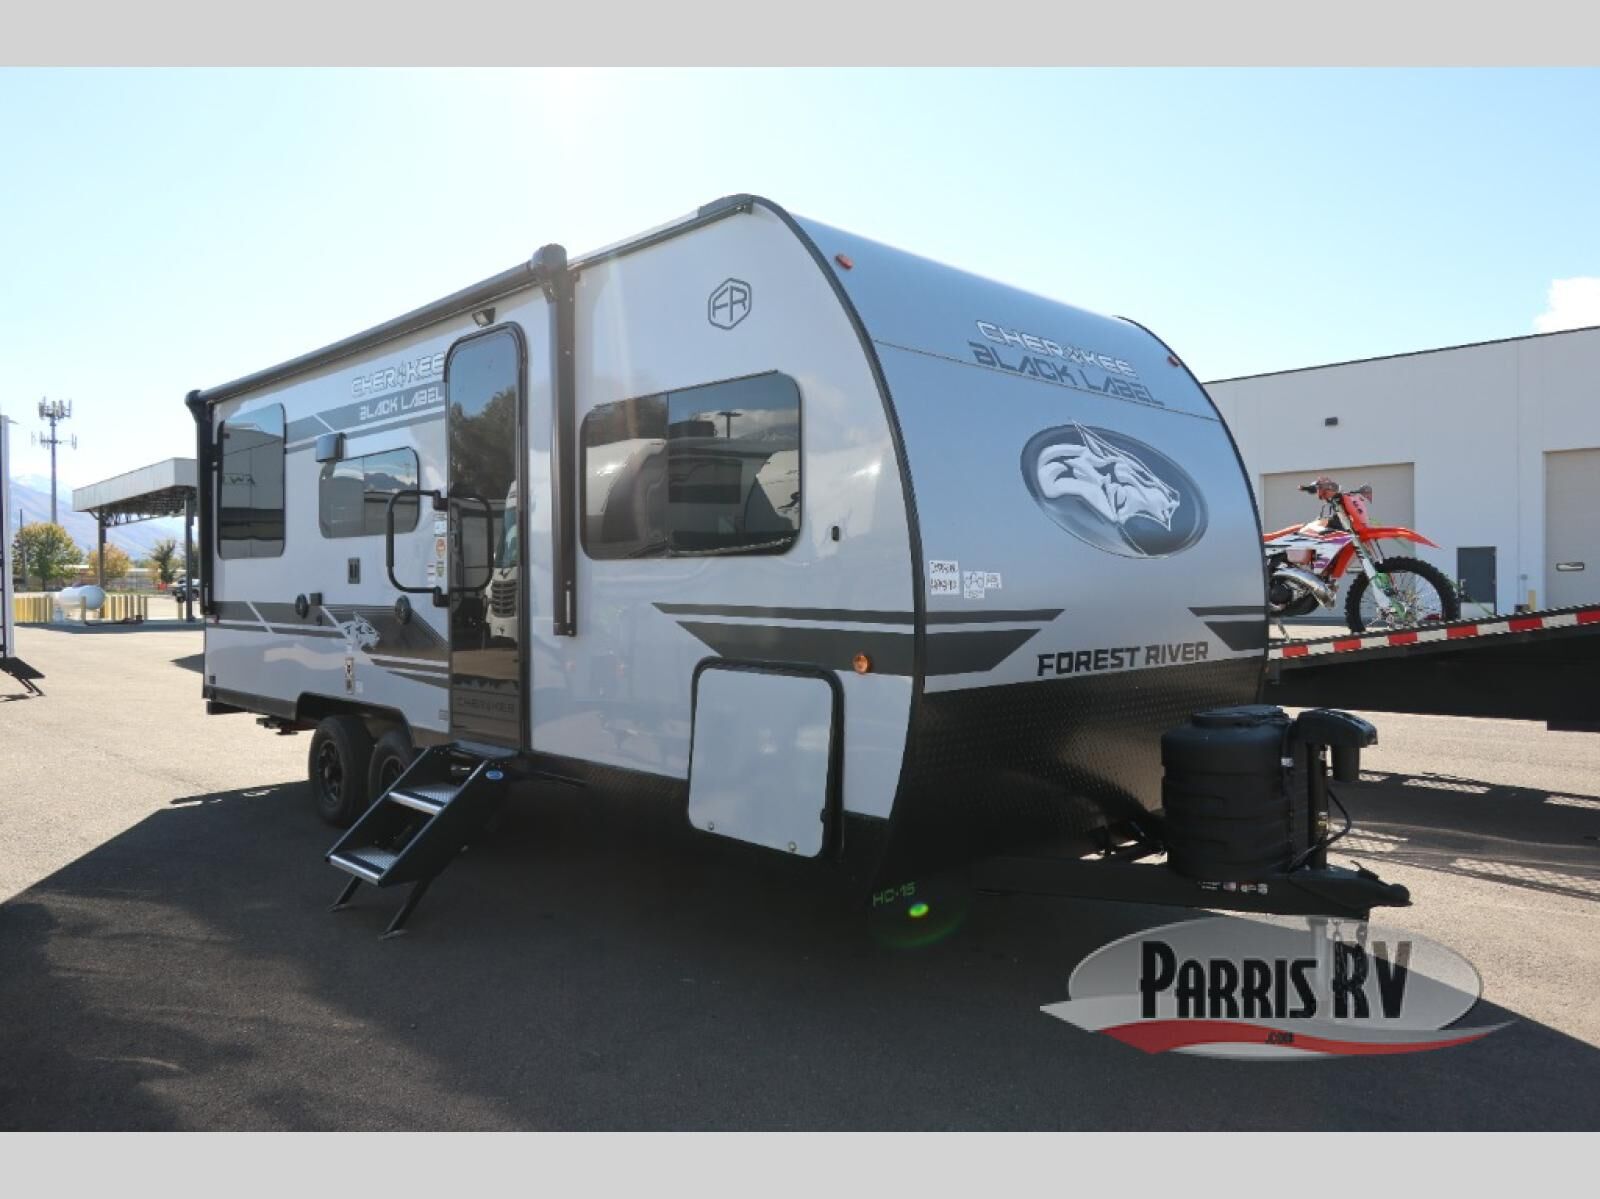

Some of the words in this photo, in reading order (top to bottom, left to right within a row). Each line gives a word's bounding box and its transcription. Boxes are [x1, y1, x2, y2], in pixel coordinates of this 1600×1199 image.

[968, 340, 1077, 385] BLACK
[1080, 370, 1165, 406] LABEL
[360, 397, 398, 421] BLACK
[401, 387, 443, 410] LABEL
[1037, 646, 1141, 676] FOREST
[1144, 641, 1209, 665] RIVER
